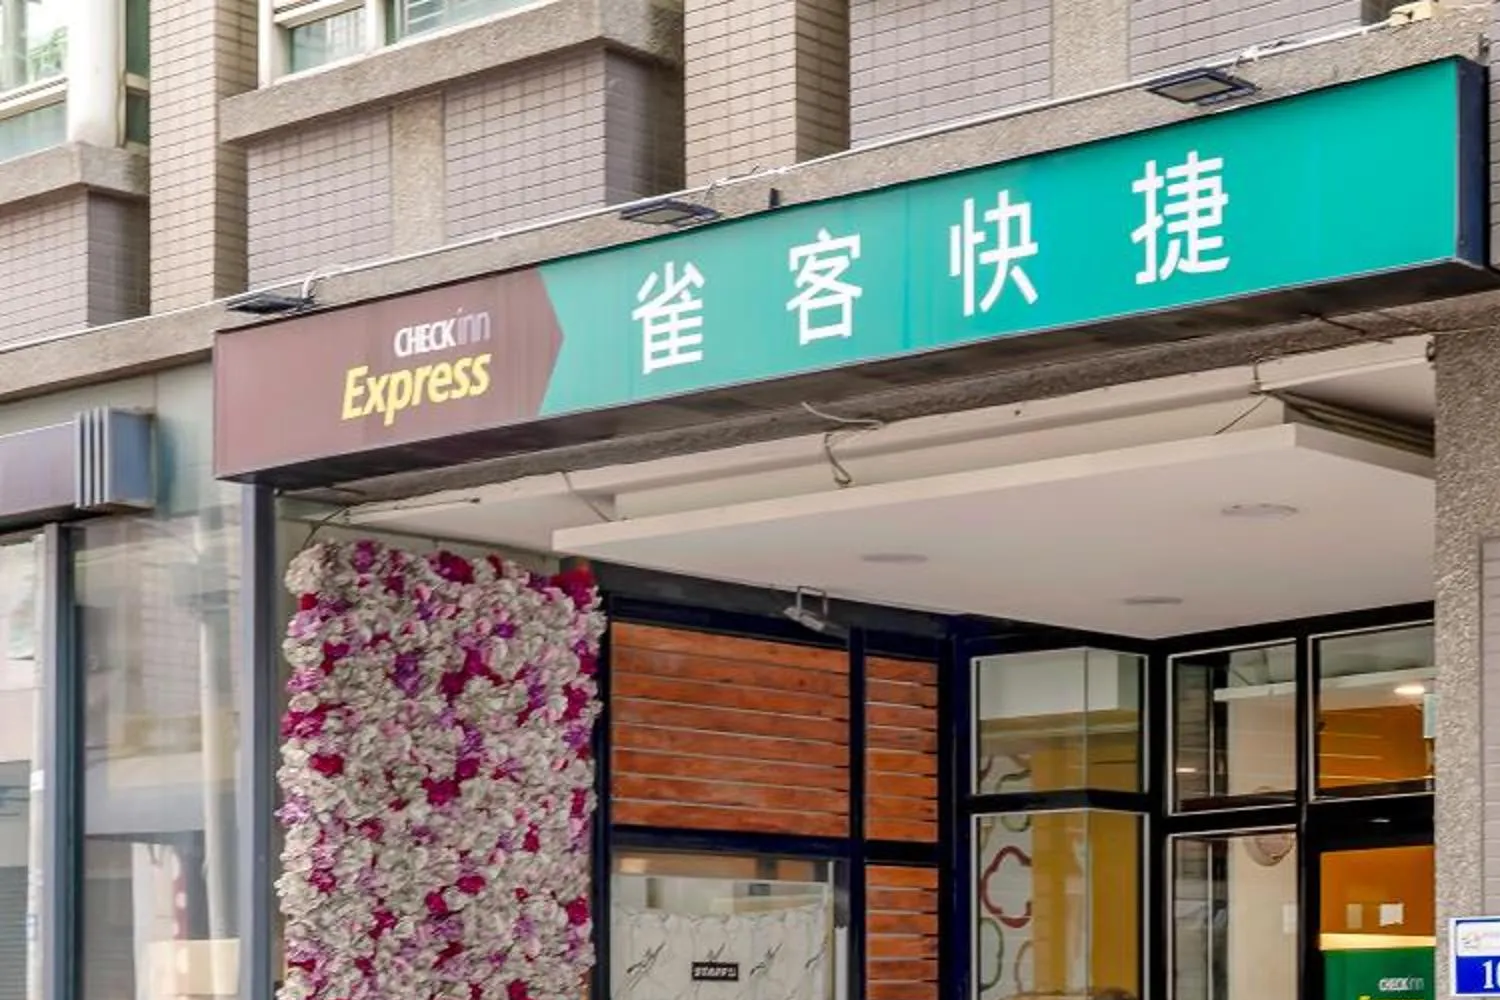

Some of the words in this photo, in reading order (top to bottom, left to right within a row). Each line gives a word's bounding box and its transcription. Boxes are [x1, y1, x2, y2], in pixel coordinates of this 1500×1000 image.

[632, 150, 1231, 374] 雀客快捷
[341, 353, 492, 426] Express
